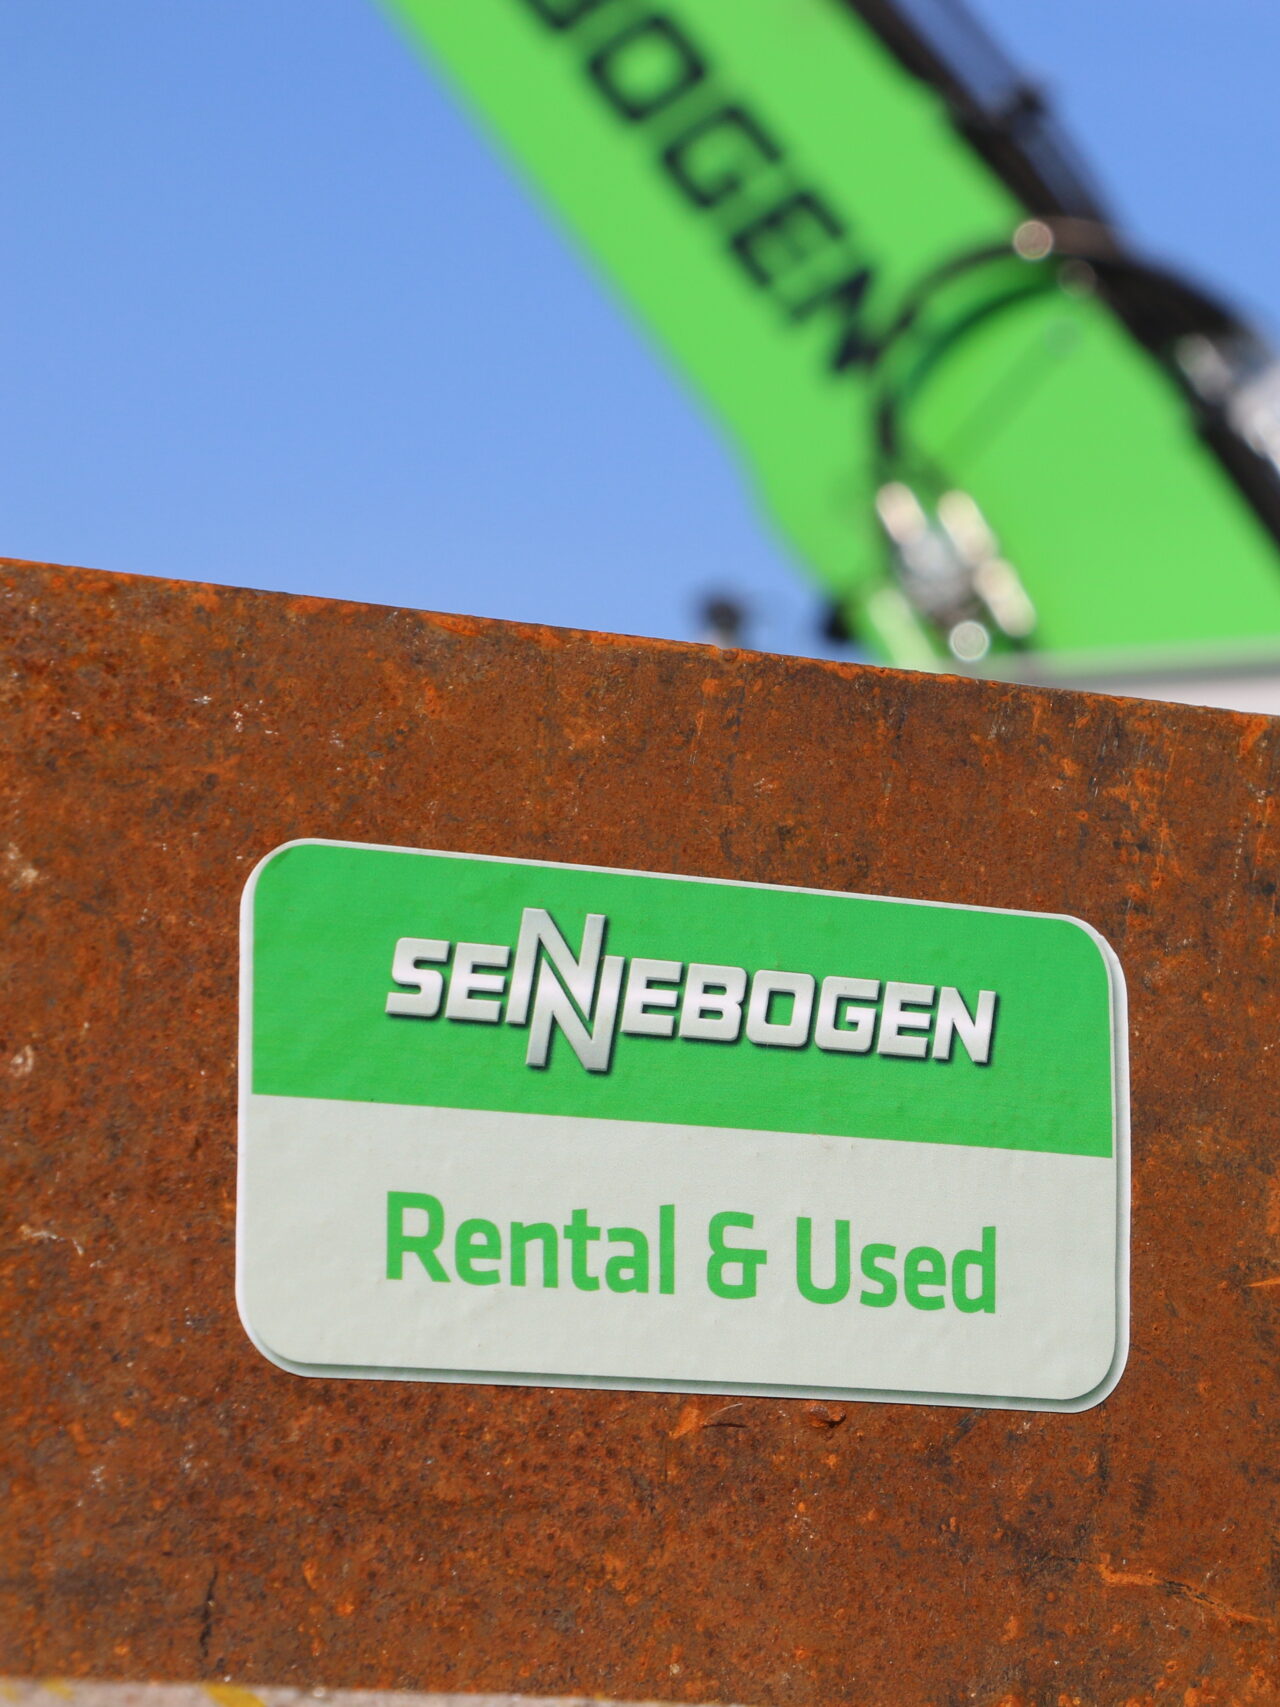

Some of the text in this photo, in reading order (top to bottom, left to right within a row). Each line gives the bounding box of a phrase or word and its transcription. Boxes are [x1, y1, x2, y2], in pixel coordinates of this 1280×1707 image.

[385, 908, 1000, 1073] SENNEBOGEN
[385, 1191, 997, 1314] Rental & Used
